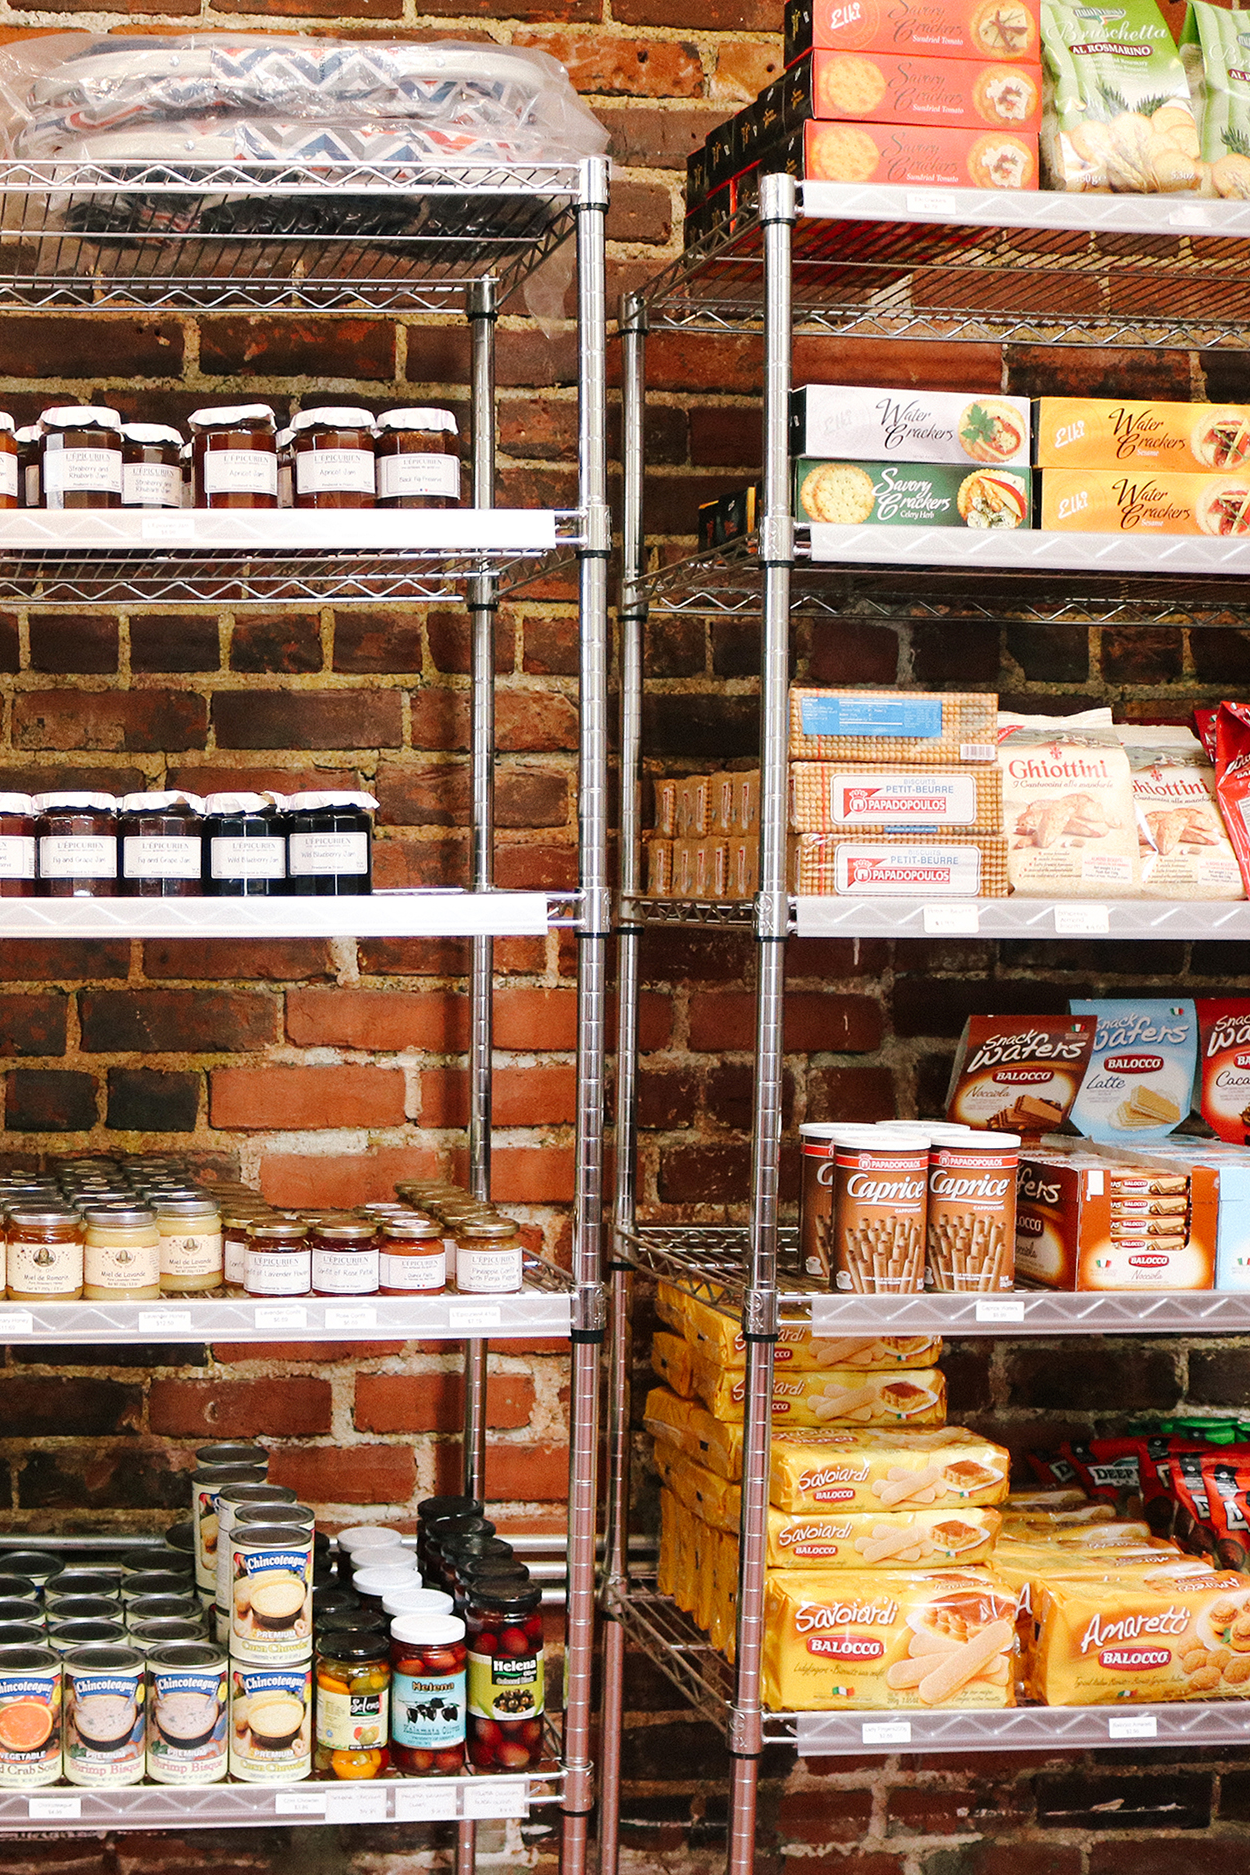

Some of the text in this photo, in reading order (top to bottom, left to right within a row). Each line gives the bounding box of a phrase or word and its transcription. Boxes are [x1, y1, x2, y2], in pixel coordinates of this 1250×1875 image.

[831, 2, 862, 29] Elki
[887, 0, 945, 20] Savory
[893, 18, 963, 43] Crackers
[1046, 20, 1168, 42] Bruschetta
[912, 35, 964, 46] Sundried Tomato
[1072, 42, 1151, 56] AL ROSMARINO
[887, 62, 946, 92] Savory
[1230, 71, 1244, 80] AL
[893, 87, 963, 111] Crackers
[912, 104, 965, 114] Sundried Tomato
[881, 131, 940, 159] Savory
[887, 156, 959, 181] Crackers
[906, 173, 959, 183] Sundried Tomato
[876, 398, 931, 427] Water
[1108, 408, 1164, 436] Water
[884, 424, 954, 450] Crackers
[1054, 420, 1085, 448] Elki
[1115, 433, 1186, 459] Crackers
[1136, 449, 1159, 457] Sesame
[871, 467, 932, 498] Savory
[1112, 478, 1168, 506] Water
[876, 493, 951, 521] Crackers
[1058, 491, 1088, 519] Elki
[900, 510, 935, 519] Celery Herb
[1120, 503, 1191, 530] Crackers
[1141, 519, 1164, 527] Sesame
[1009, 758, 1109, 780] Ghiottini
[886, 785, 954, 794] PETIT-BEURRE
[868, 799, 946, 811] PAPADOPOULOS
[890, 856, 959, 865] PETIT-BEURRE
[872, 869, 949, 881] PAPADOPOULOS
[983, 1029, 1038, 1051] Snack
[1108, 1058, 1162, 1068] BALOCCO
[996, 1072, 1051, 1080] BALOCCO
[1086, 1074, 1127, 1090] Latte
[965, 1085, 1010, 1097] Nocciola
[872, 1160, 921, 1168] PAPADOPOULOS
[950, 1157, 1003, 1167] PAPADOPOULOS
[847, 1173, 926, 1203] Caprice
[930, 1170, 1010, 1198] Caprice
[1130, 1256, 1169, 1265] BALOCCO
[1131, 1270, 1163, 1280] Nocciola
[798, 1465, 871, 1491] Savoiardi
[1095, 1468, 1133, 1481] DEEP
[815, 1489, 854, 1500] BALOCCO
[779, 1521, 853, 1546] Savoiardi
[795, 1546, 836, 1555] BALOCCO
[248, 1556, 306, 1569] Chincoteague
[795, 1596, 899, 1633] Savoiardi
[256, 1630, 296, 1639] PREMIUM
[1081, 1604, 1191, 1653] Amaretti
[242, 1641, 263, 1652] Corn
[811, 1639, 881, 1655] BALOCCO
[1103, 1651, 1169, 1664] BALOCCO
[493, 1659, 537, 1672] Helena
[76, 1679, 137, 1694] Chincoteague
[158, 1677, 218, 1692] Chincoteague
[246, 1676, 305, 1689] Chincoteague
[411, 1681, 455, 1692] Helena
[0, 1751, 47, 1760] VEGETABLE
[85, 1750, 126, 1759] PREMIUM
[167, 1749, 208, 1758] PREMIUM
[254, 1749, 294, 1758] PREMIUM
[7, 1763, 36, 1776] Crab
[37, 1761, 58, 1775] Soup
[70, 1761, 141, 1777] Shrimp Bisque
[151, 1759, 223, 1774] Shrimp Bisque
[240, 1761, 263, 1771] Corn
